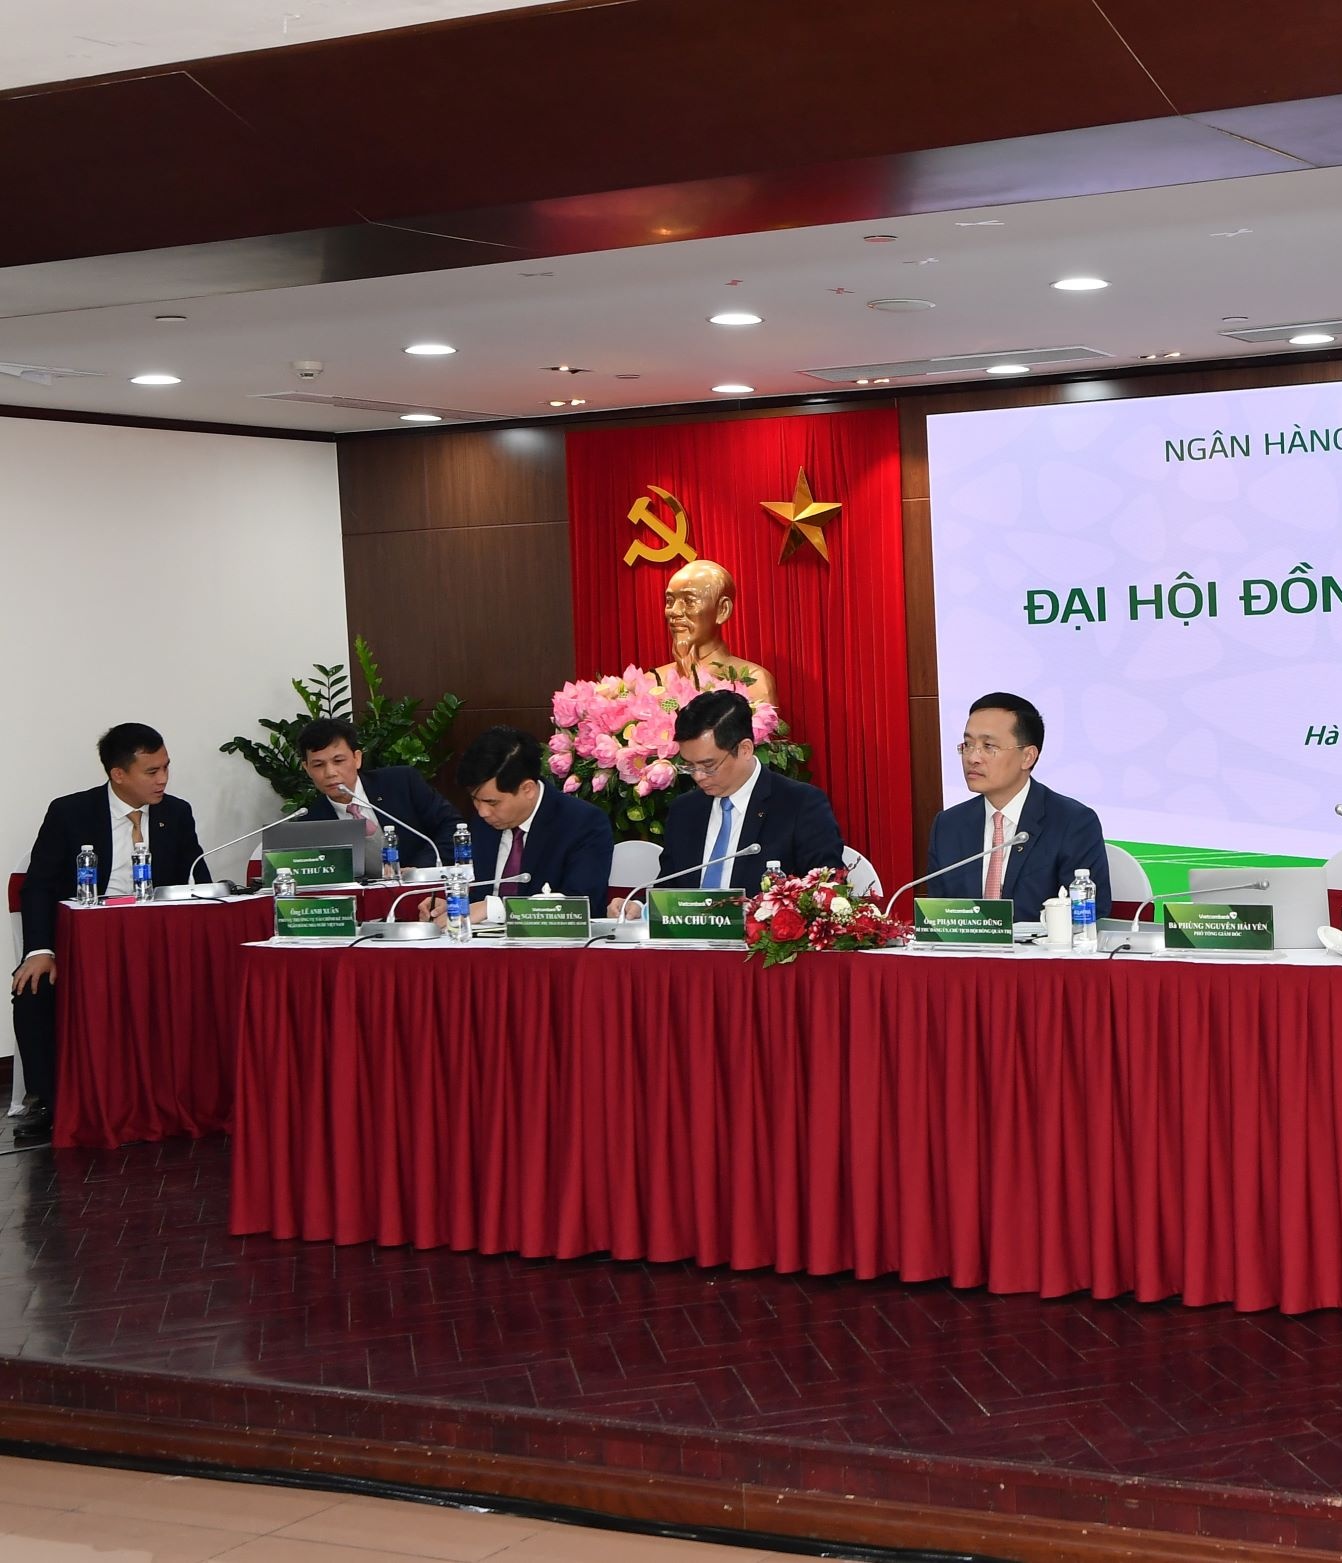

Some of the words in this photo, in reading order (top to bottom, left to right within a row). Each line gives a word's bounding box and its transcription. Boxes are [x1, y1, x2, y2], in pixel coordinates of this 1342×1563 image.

[1165, 429, 1250, 463] NGÂN
[1023, 586, 1107, 631] ĐẠI
[1128, 571, 1218, 627] HỘI
[1304, 724, 1340, 746] Hà
[301, 866, 322, 875] THƯ
[662, 915, 683, 925] BAN
[684, 913, 707, 925] CHỦ
[708, 915, 731, 927] TỌA
[923, 916, 936, 926] Ông
[936, 918, 957, 927] PHẠM
[957, 919, 982, 927] QUANG
